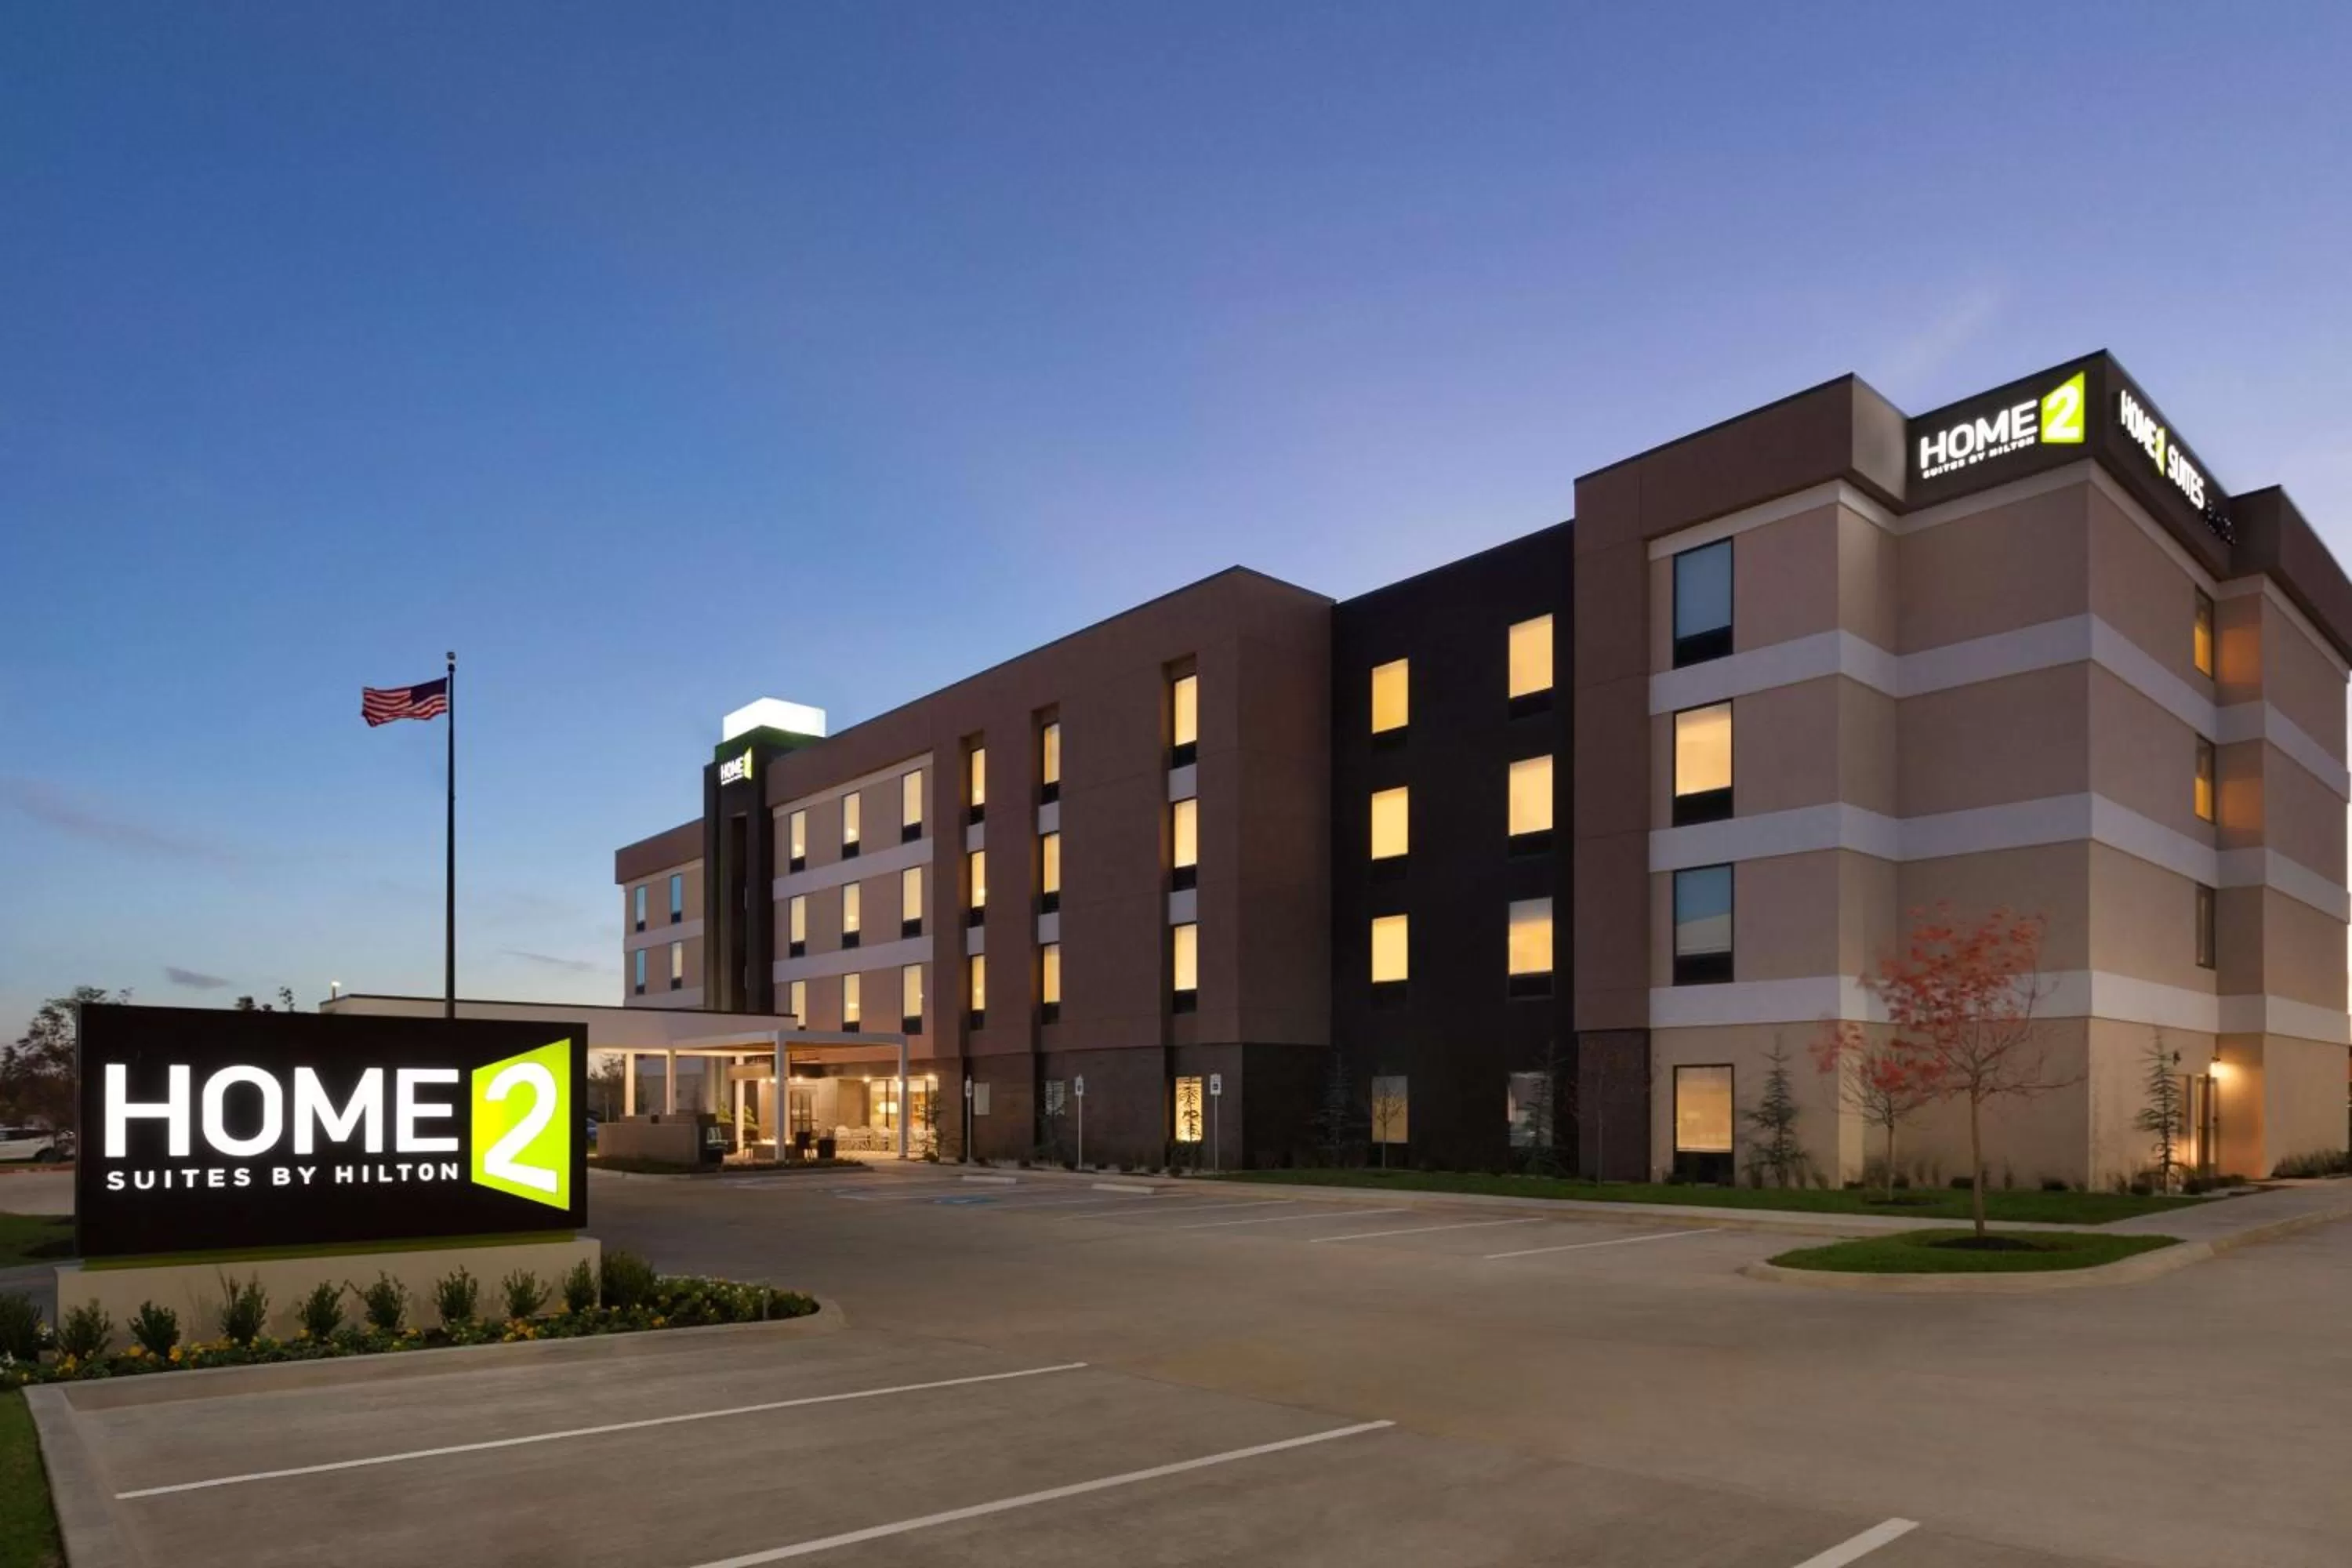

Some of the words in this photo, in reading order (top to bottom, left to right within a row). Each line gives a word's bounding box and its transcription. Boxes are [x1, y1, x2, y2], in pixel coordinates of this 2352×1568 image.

[2167, 444, 2205, 510] SUITES
[103, 1062, 459, 1159] HOME
[106, 1168, 251, 1192] SUITES
[272, 1166, 317, 1186] BY
[335, 1162, 459, 1184] HILTON
